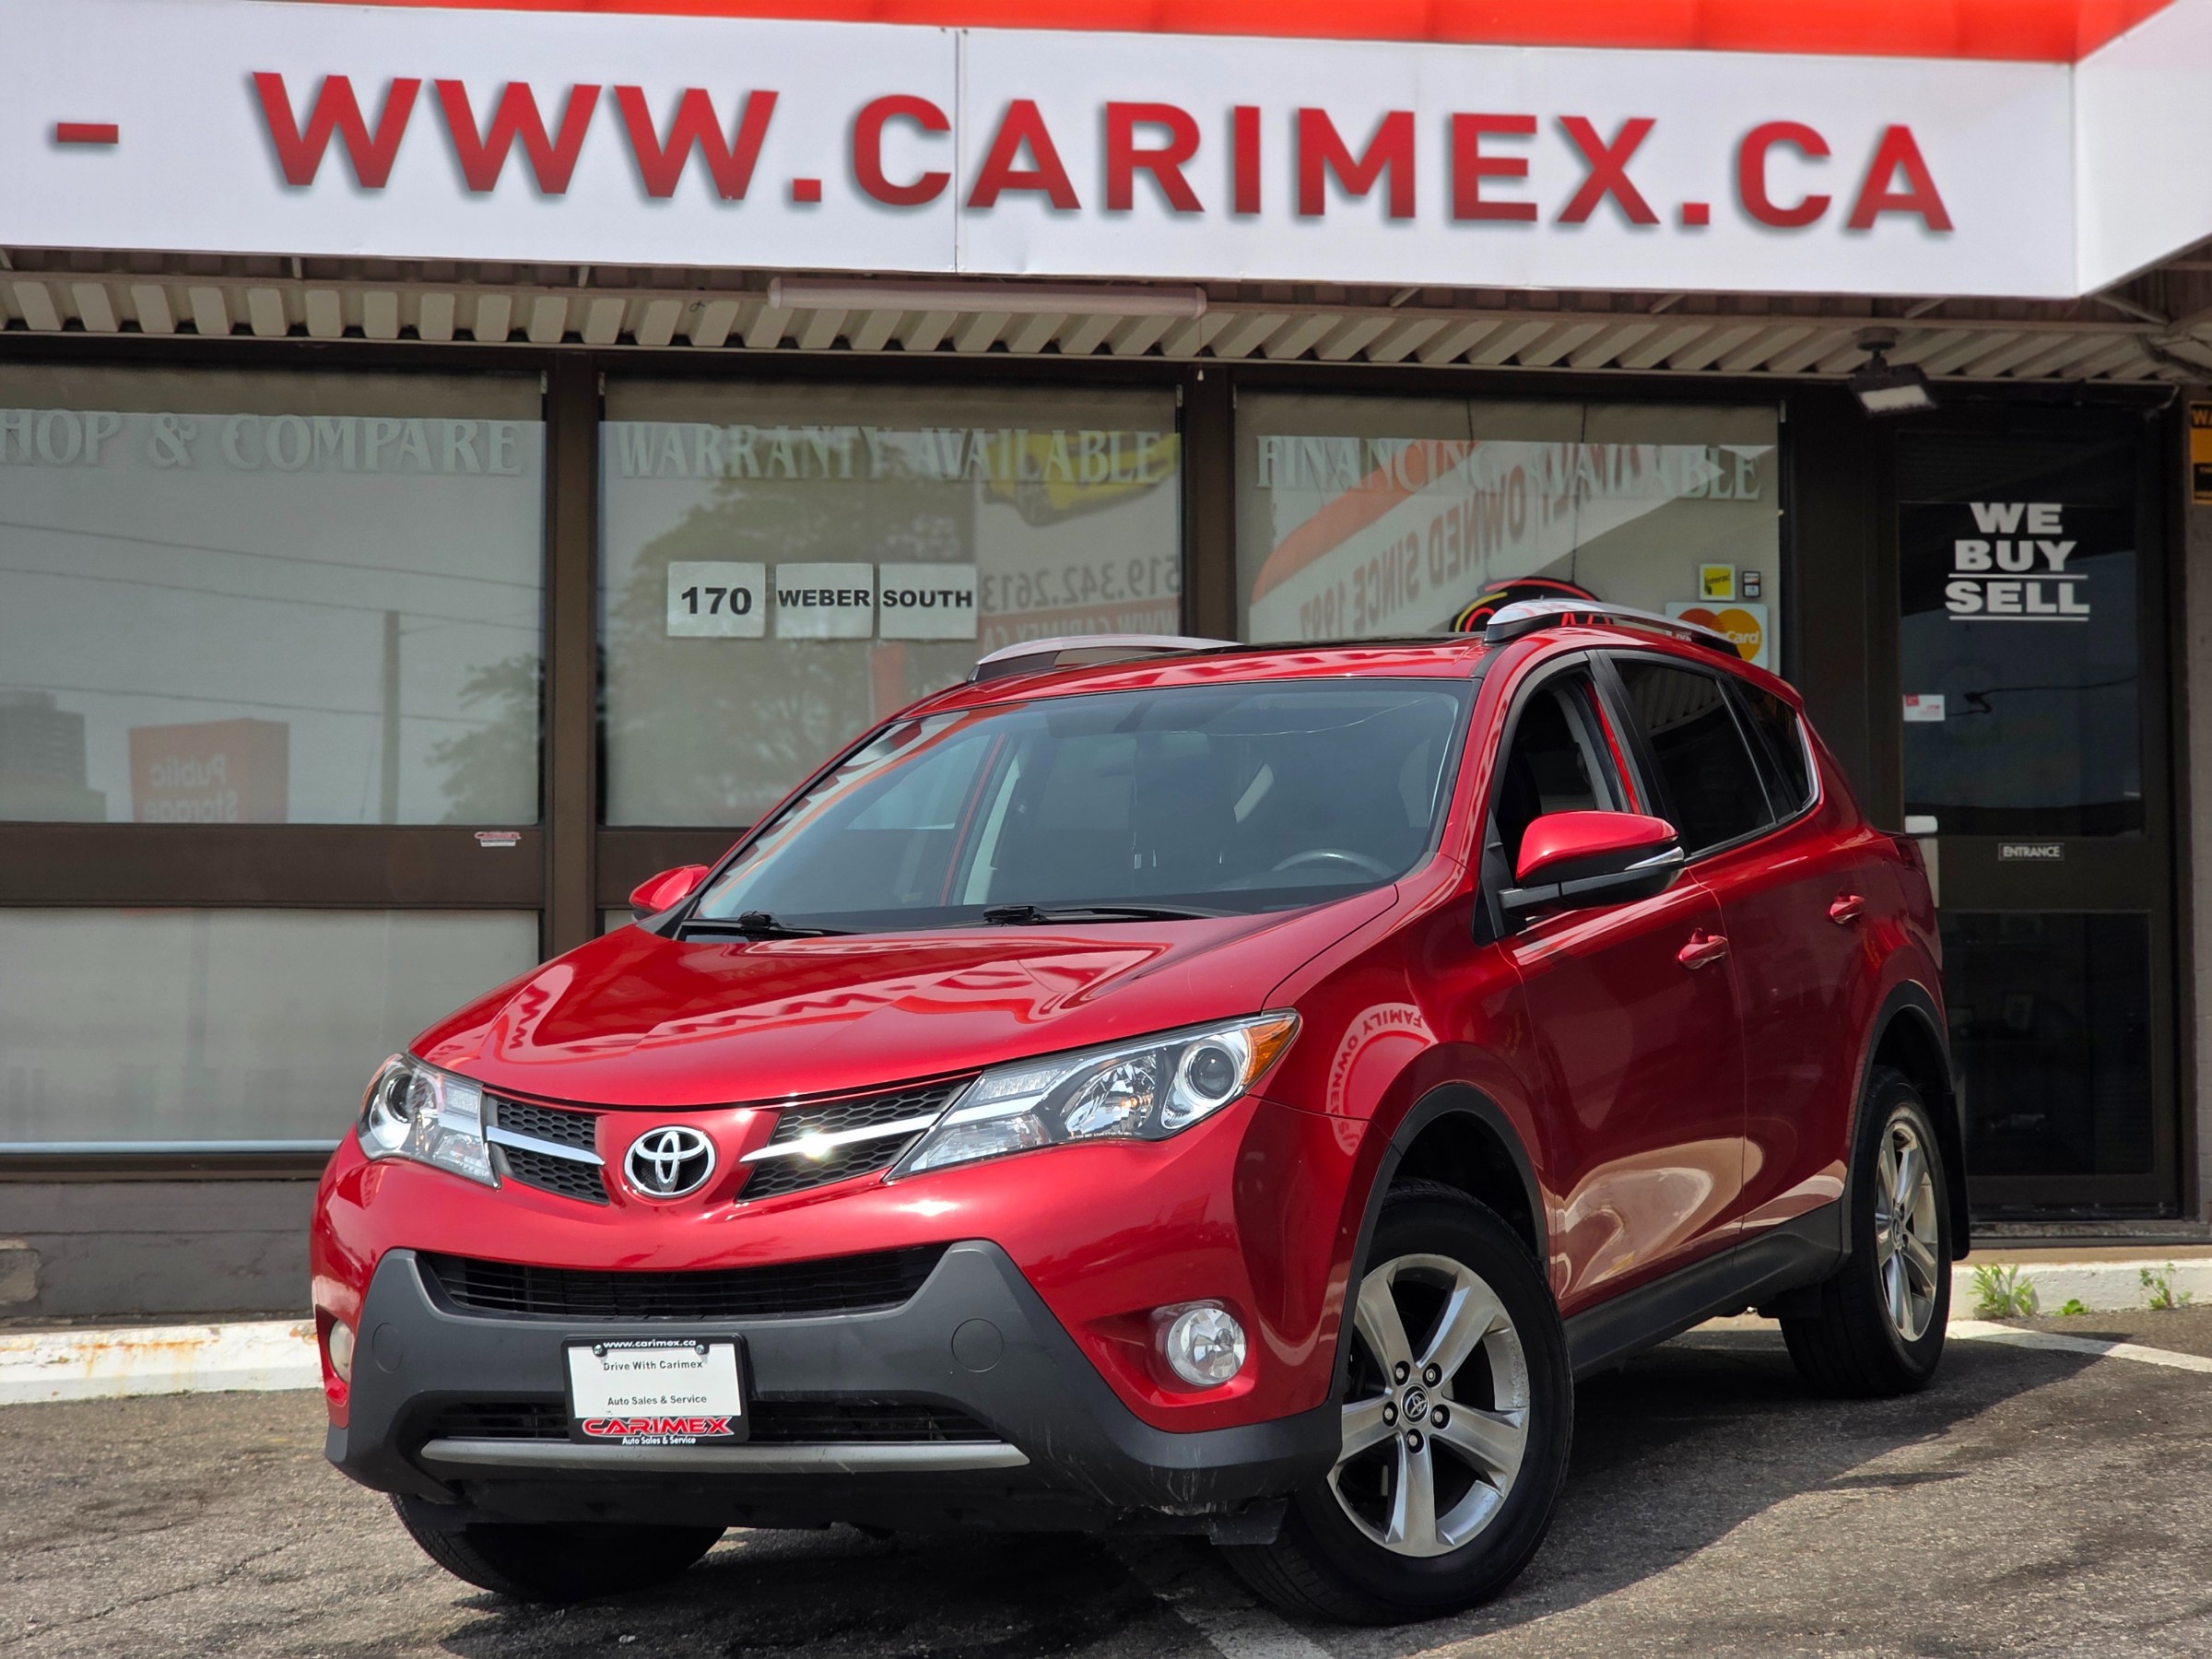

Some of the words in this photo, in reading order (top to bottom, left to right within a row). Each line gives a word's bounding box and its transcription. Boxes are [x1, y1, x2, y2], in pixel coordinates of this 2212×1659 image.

[252, 72, 1954, 232] WWW.CARIMEX.CA
[147, 411, 196, 466] &
[222, 413, 523, 476] COMPARE
[617, 422, 892, 479] WARRANTY
[907, 428, 1161, 484] AVAILABLE
[1256, 435, 1504, 493] FINANCING
[1519, 442, 1761, 500] AVAILABLE
[1969, 502, 2064, 535] WE
[1954, 539, 2077, 572] BUY
[680, 586, 753, 616] 170
[778, 589, 871, 607] WEBER
[882, 590, 973, 608] SOUTH
[1945, 581, 2090, 614] SELL
[2003, 845, 2061, 858] ENTRANCE
[603, 1339, 697, 1348] www.carimex.ca
[604, 1362, 630, 1371] Drive
[632, 1361, 657, 1371] With
[659, 1359, 703, 1370] Carimex
[607, 1396, 629, 1406] Auto
[631, 1396, 658, 1405] Sales
[660, 1395, 667, 1404] &
[670, 1394, 708, 1404] Service
[582, 1416, 735, 1437] CARIMEX
[622, 1437, 640, 1445] Auto
[641, 1436, 661, 1445] Sales
[669, 1436, 697, 1444] Service
